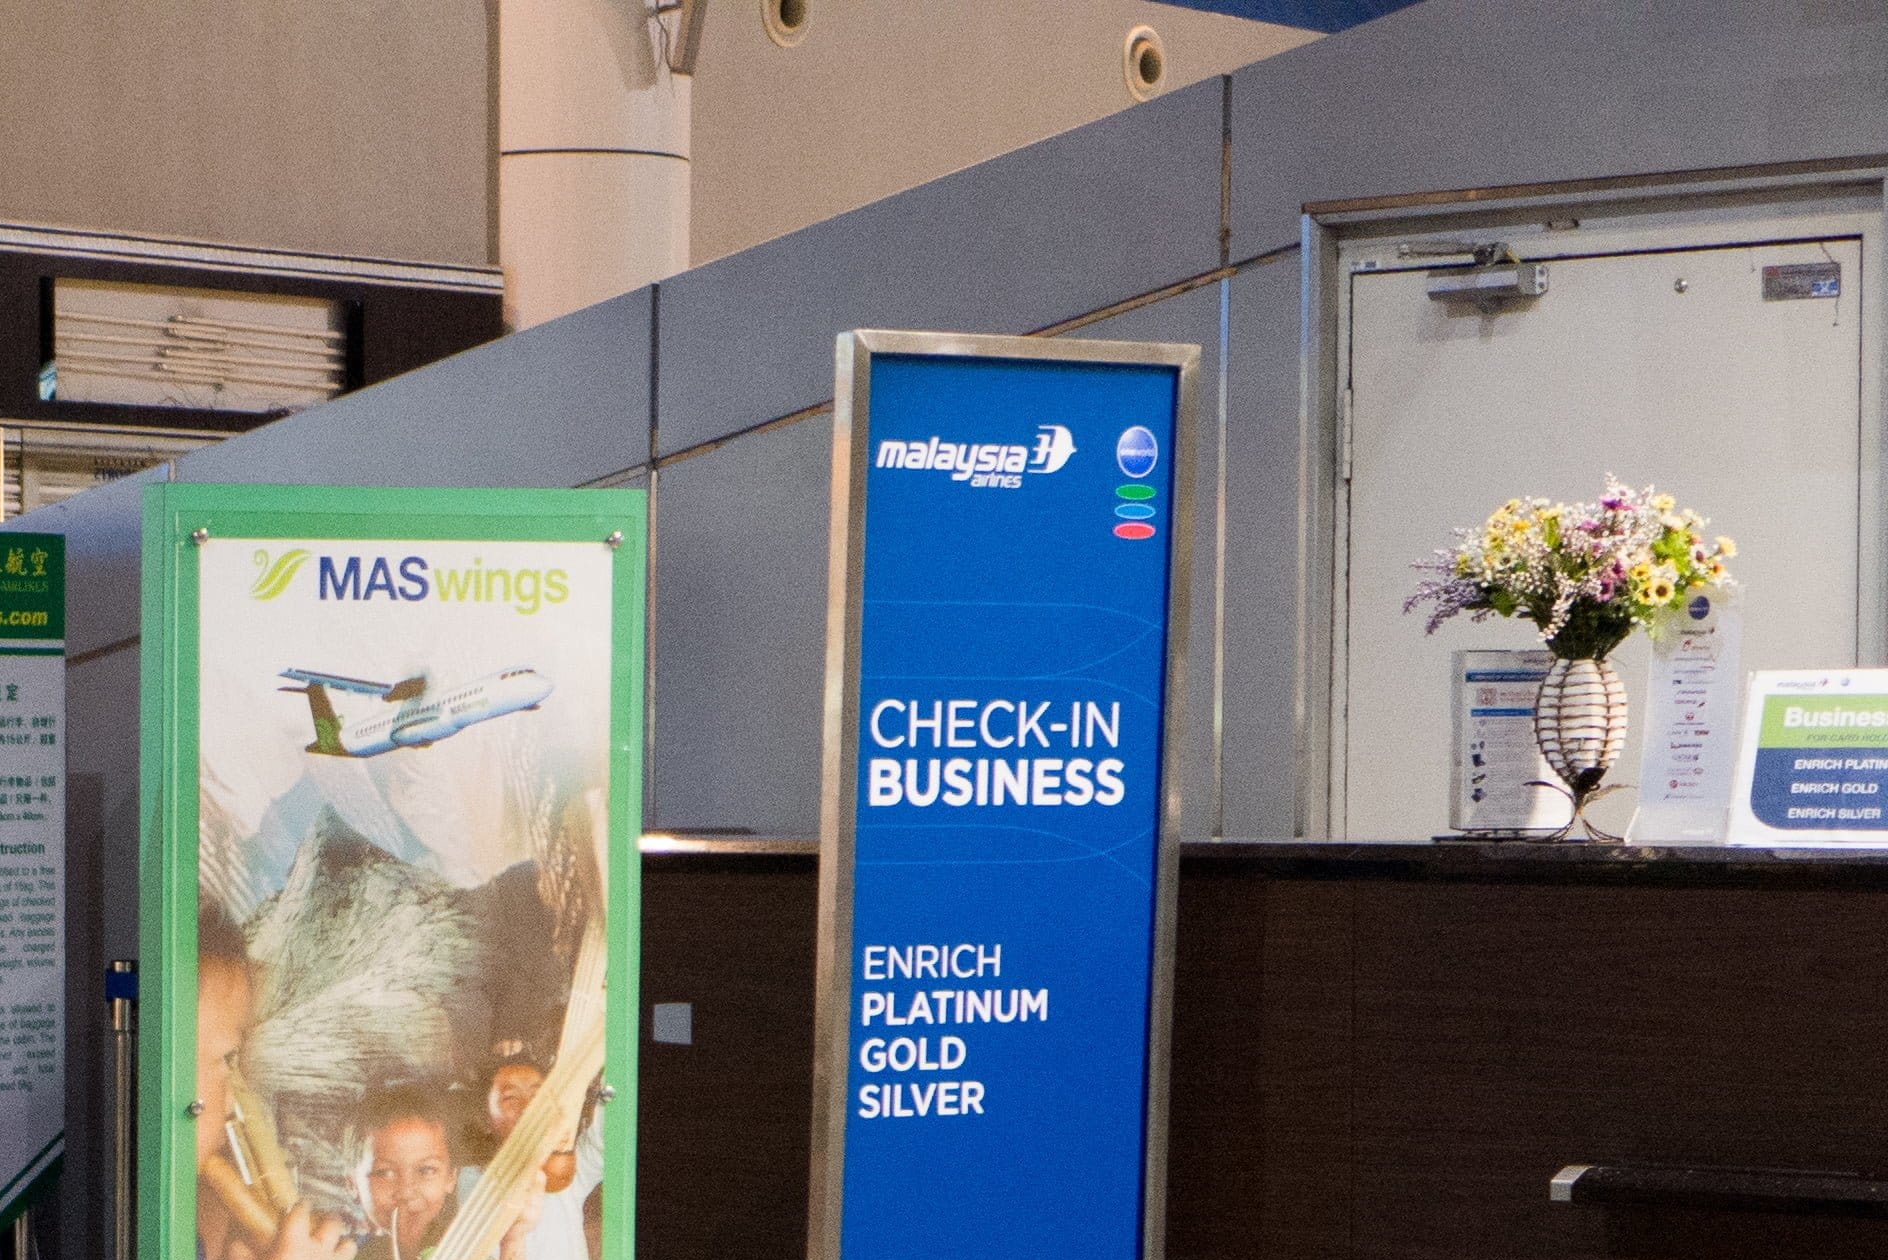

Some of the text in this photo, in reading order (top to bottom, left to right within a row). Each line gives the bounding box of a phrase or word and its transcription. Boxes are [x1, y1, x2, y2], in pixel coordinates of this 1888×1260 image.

[875, 436, 1029, 482] malaysia
[970, 473, 1022, 489] airlines
[319, 556, 570, 615] MASwings
[870, 699, 1120, 748] CHECK-IN
[1784, 706, 1888, 728] Busines
[869, 758, 1125, 807] BUSINESS
[1794, 759, 1888, 770] ENRICH PLATIN
[1790, 782, 1878, 794] ENRICH GOLD
[1787, 807, 1881, 819] ENRICH SILVER
[864, 943, 1002, 980] ENRICH
[862, 988, 1049, 1026] PLATINUM
[860, 1036, 967, 1072] GOLD
[858, 1081, 985, 1119] SILVER
